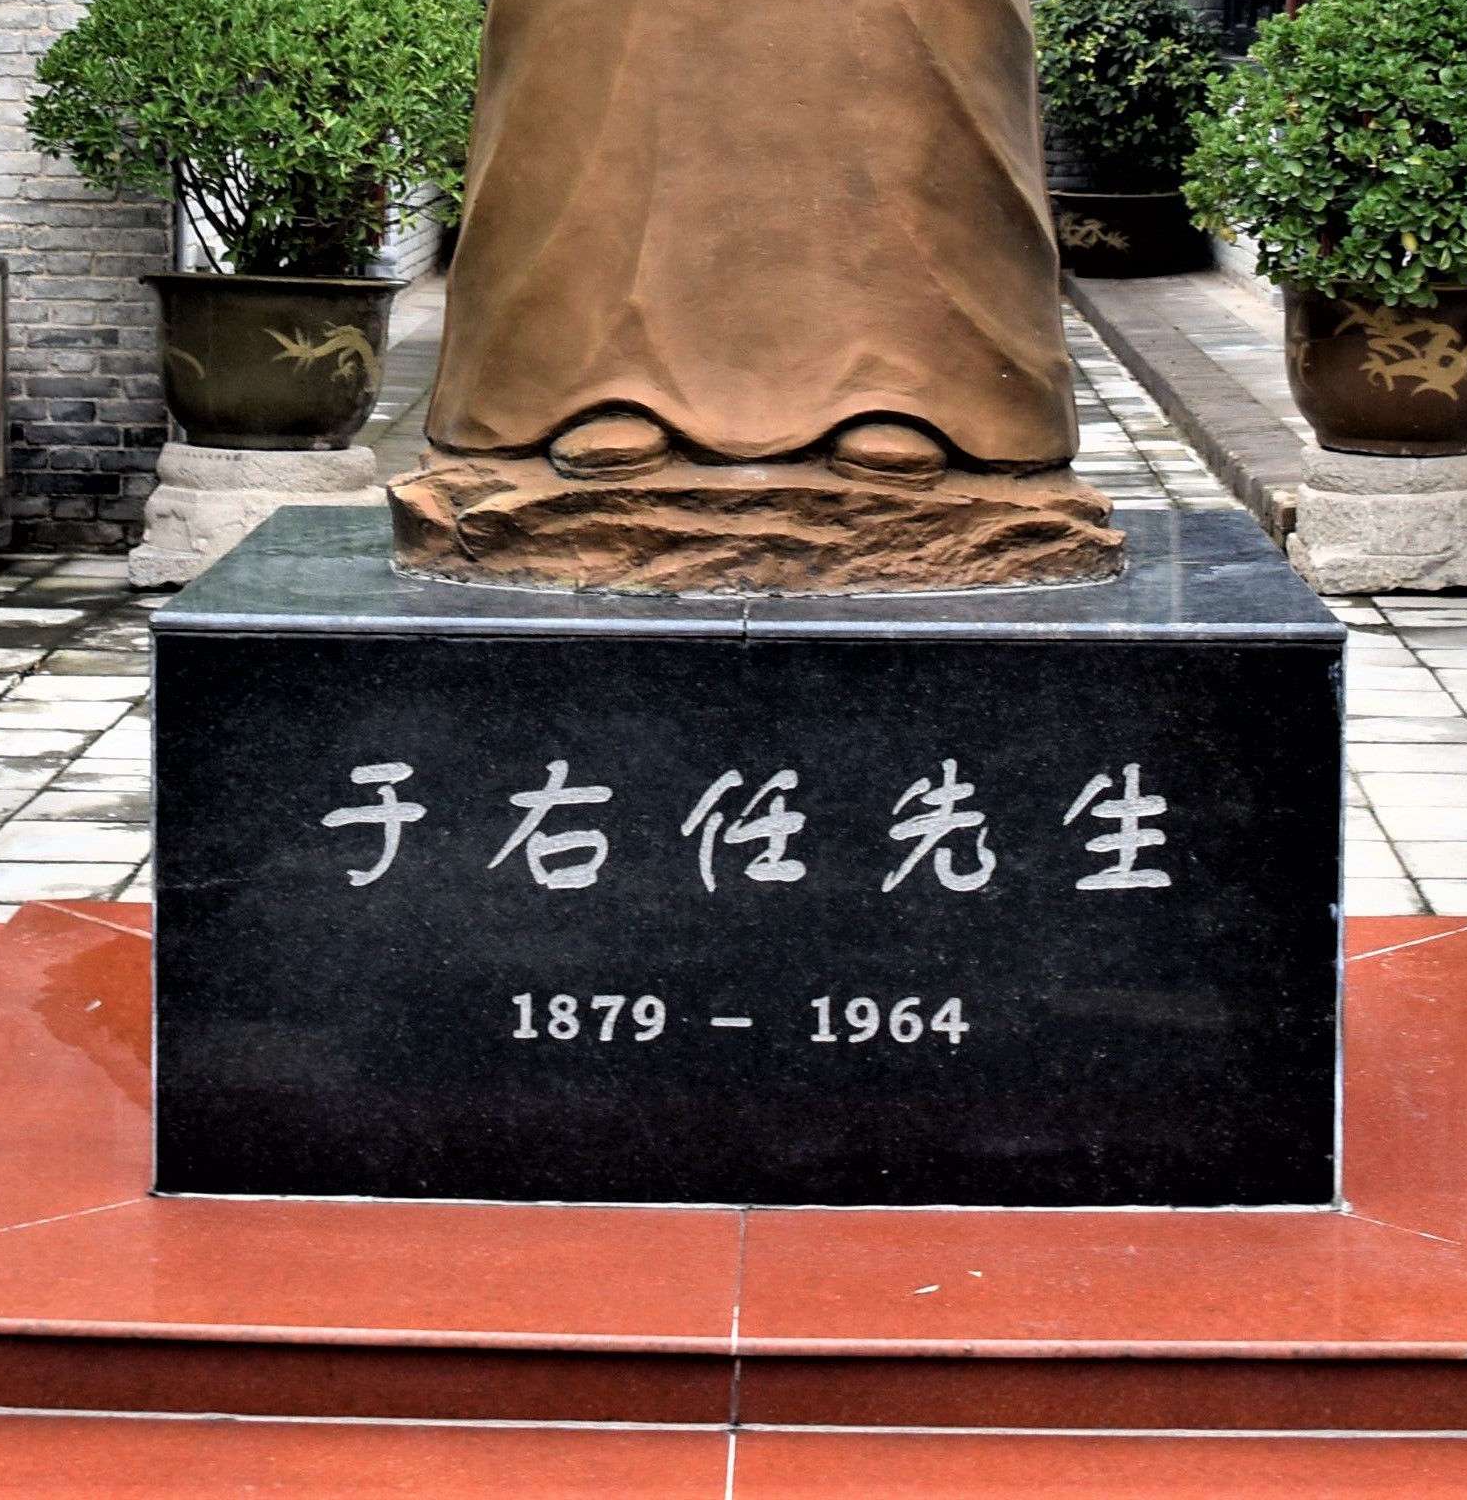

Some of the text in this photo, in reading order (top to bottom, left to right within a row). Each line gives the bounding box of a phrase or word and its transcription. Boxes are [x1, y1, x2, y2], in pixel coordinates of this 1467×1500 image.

[320, 758, 1172, 894] 于右任先生
[511, 992, 667, 1043] 1879
[809, 995, 971, 1046] 1964
